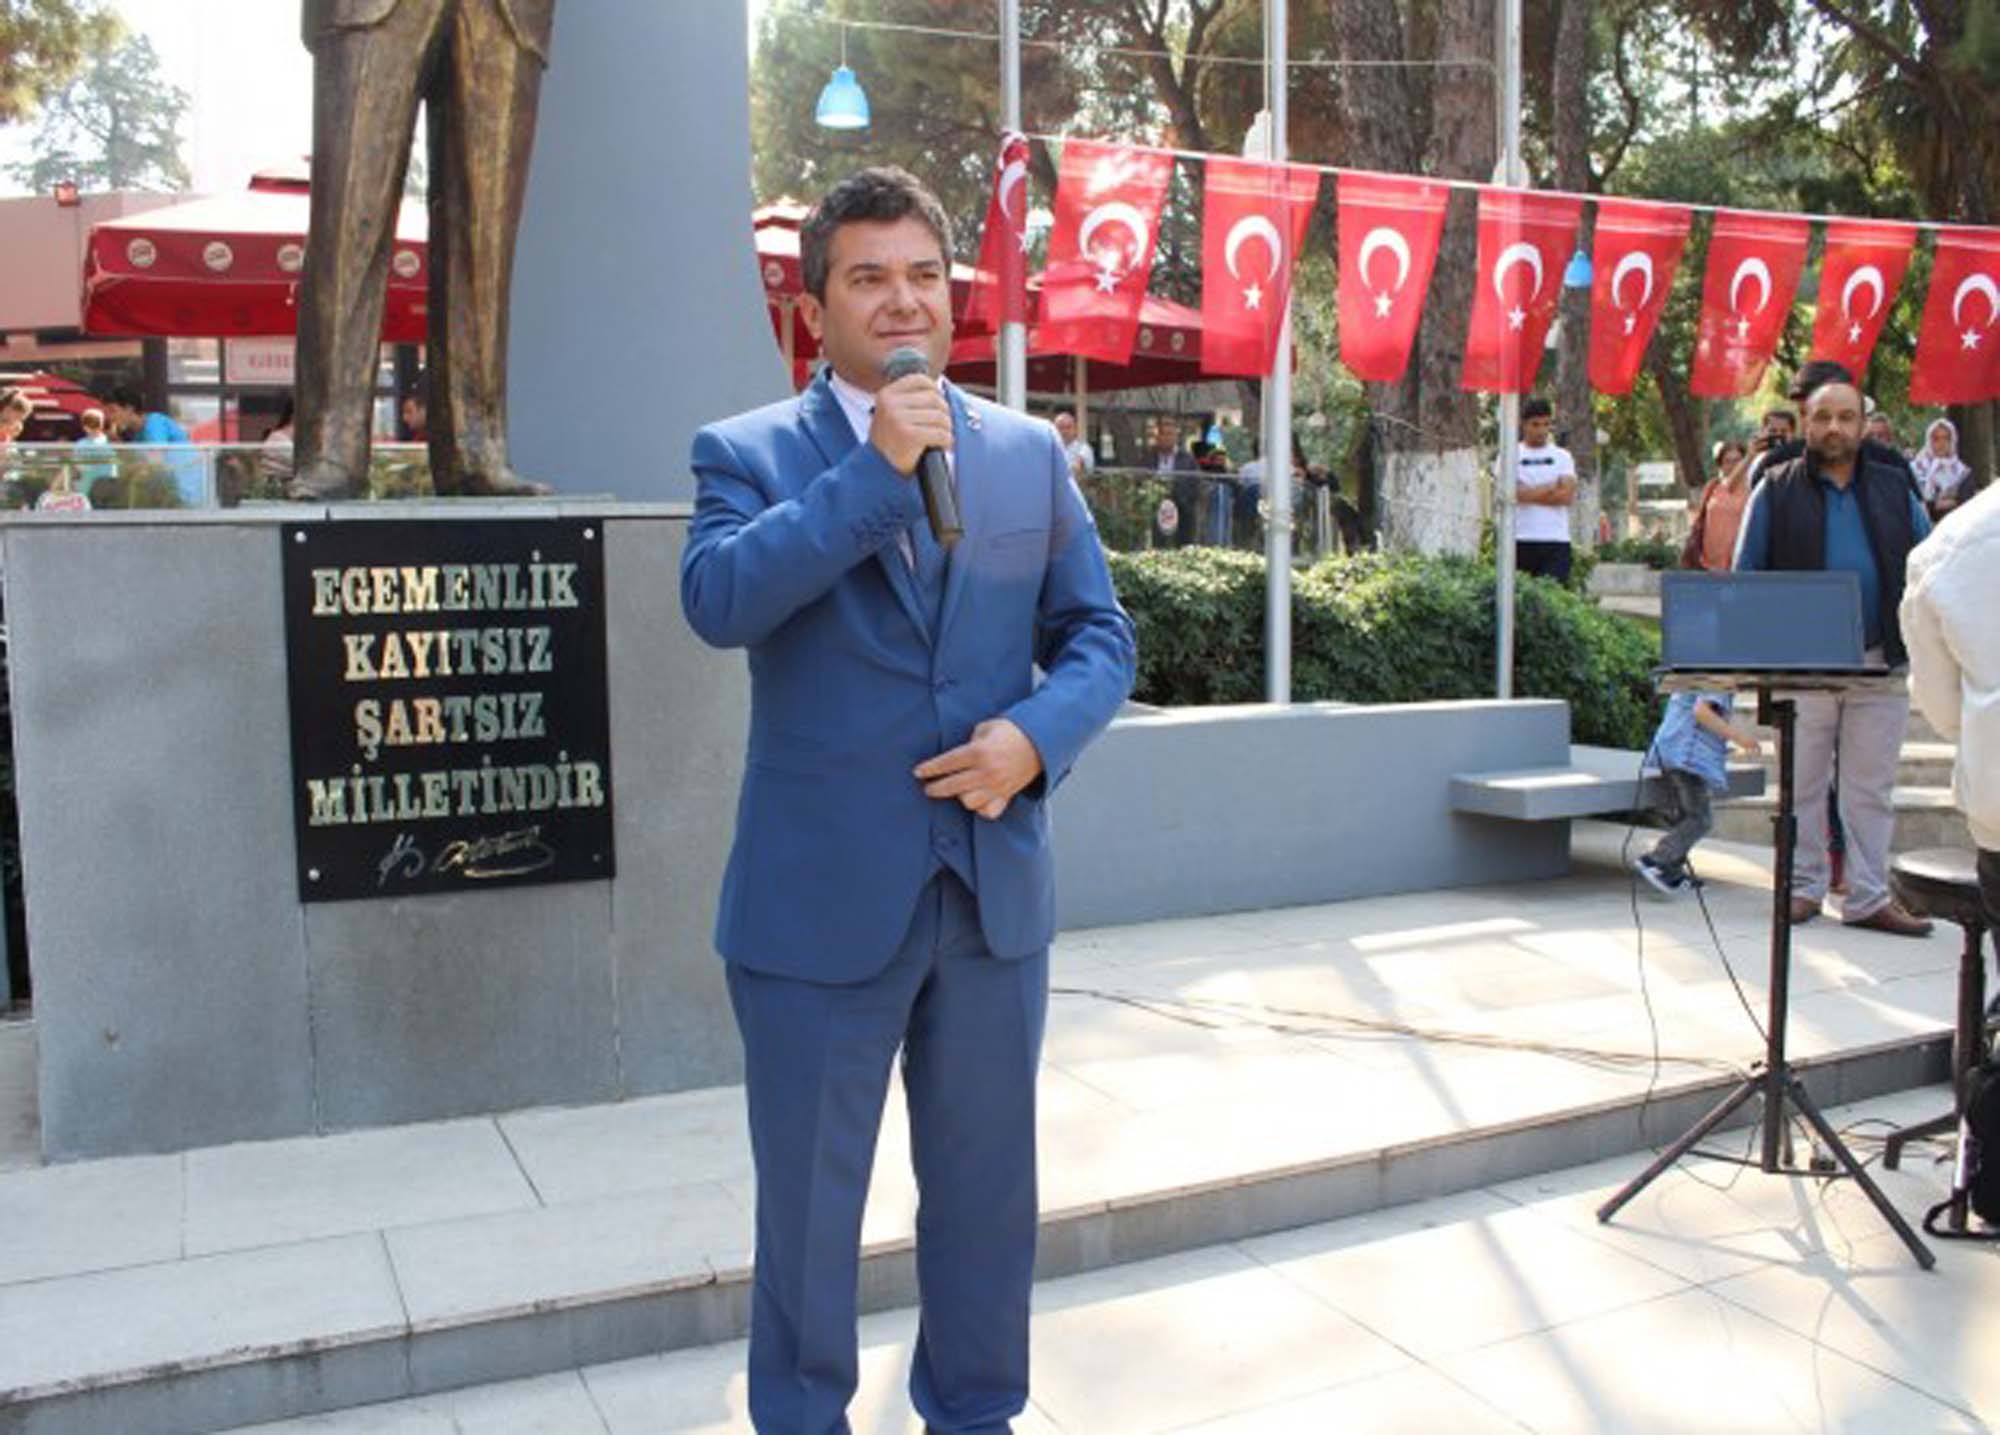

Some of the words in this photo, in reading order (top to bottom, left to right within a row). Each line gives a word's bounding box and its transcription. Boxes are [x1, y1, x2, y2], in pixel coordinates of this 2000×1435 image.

[312, 550, 579, 615] EGEMENLİK
[343, 627, 553, 681] KAYITSIZ
[355, 693, 545, 760] ŞARTSIZ
[308, 750, 604, 826] MİLLETİNDİR
